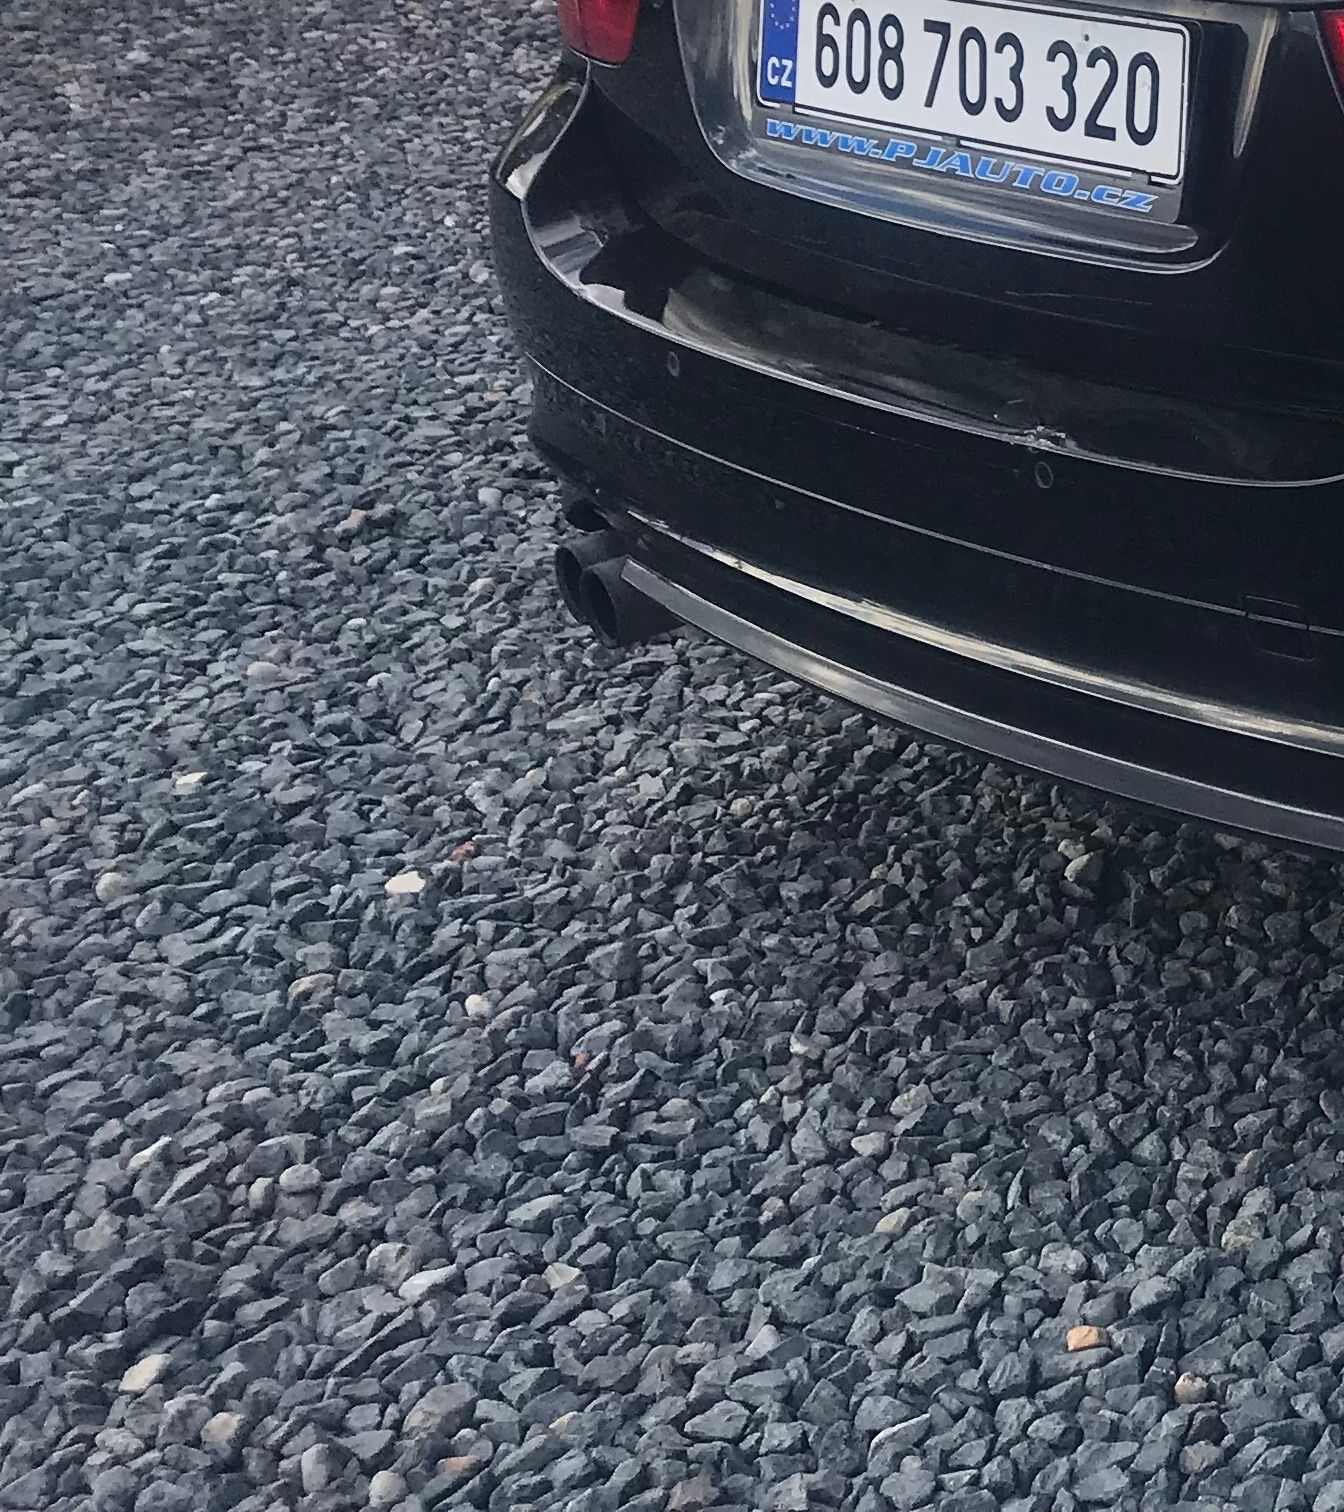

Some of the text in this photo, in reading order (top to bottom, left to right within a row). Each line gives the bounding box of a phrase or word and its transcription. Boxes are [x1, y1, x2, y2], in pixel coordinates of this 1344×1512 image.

[766, 55, 794, 89] CZ
[814, 1, 1161, 147] 608 703 320
